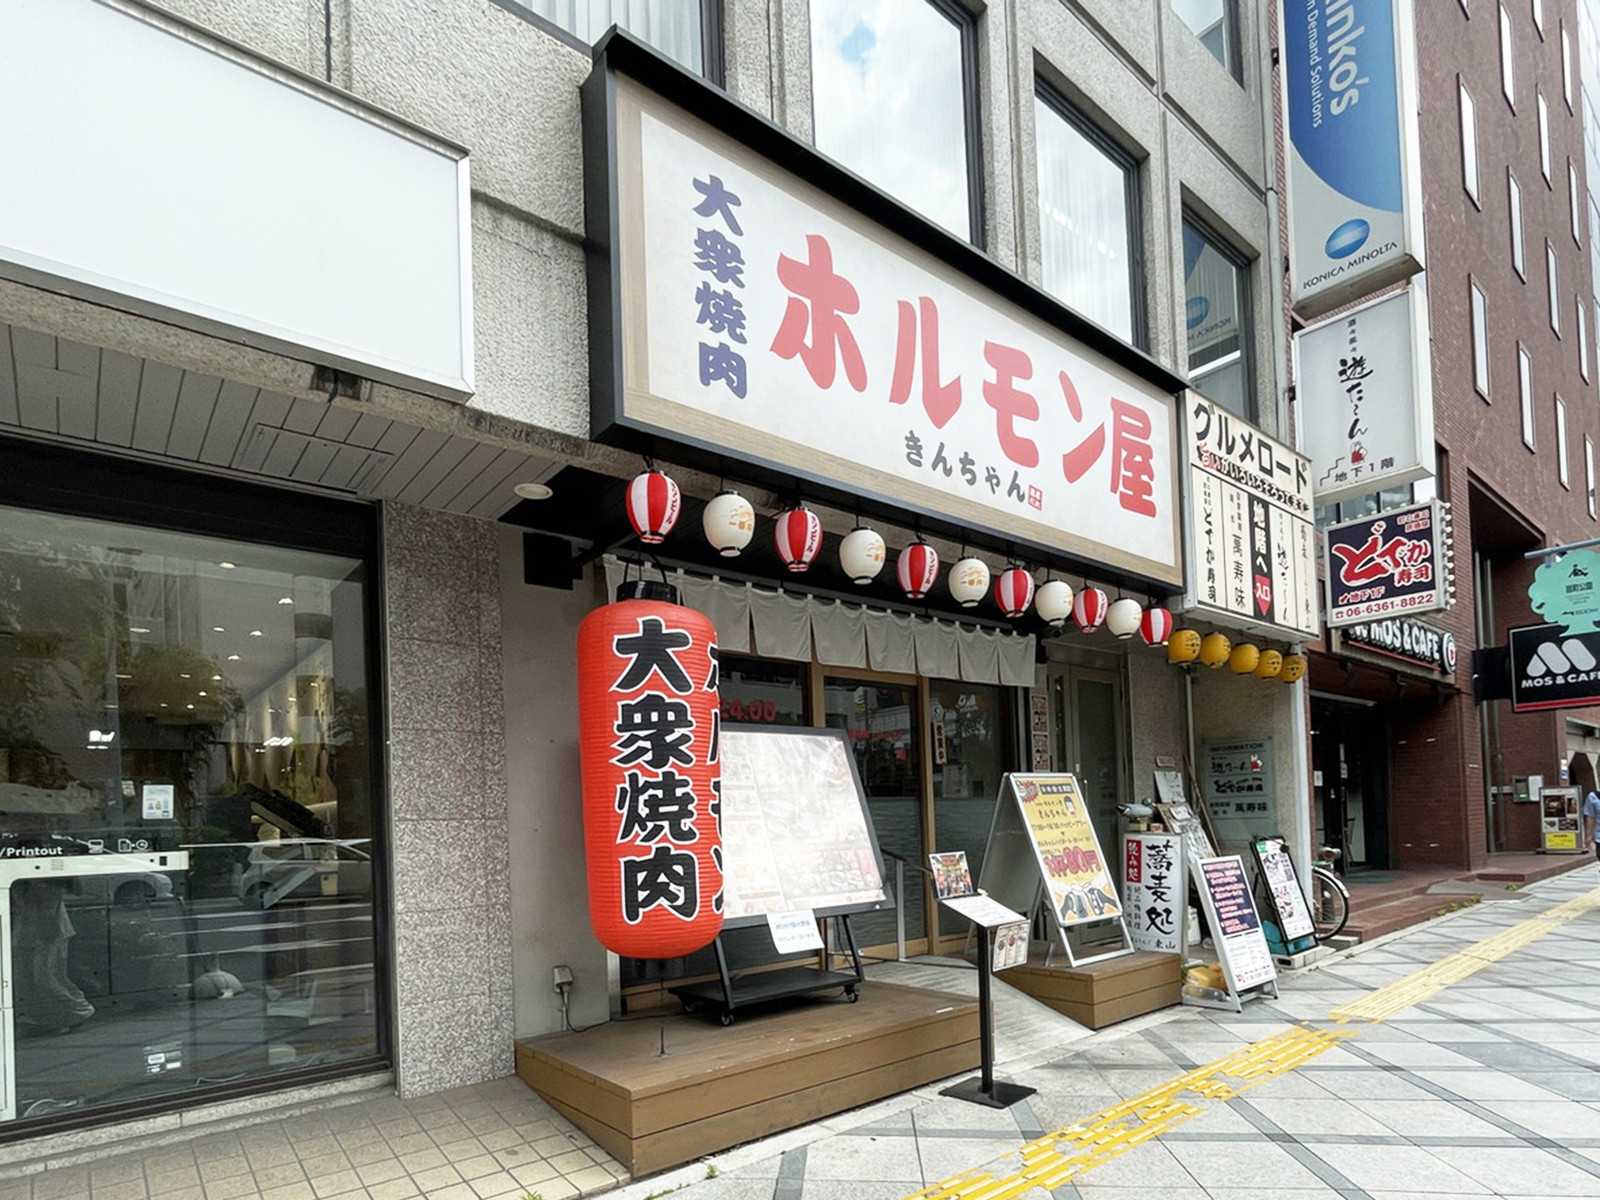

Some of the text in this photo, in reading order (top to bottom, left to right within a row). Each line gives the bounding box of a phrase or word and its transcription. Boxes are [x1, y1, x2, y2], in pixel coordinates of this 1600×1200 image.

[1307, 9, 1322, 66] Demand
[1310, 65, 1324, 128] Solutions
[692, 174, 748, 399] 大衆焼肉
[1303, 241, 1398, 290] KONICA MINOLTA
[769, 233, 1157, 518] ホルモン屋
[904, 430, 1026, 503] きんちゃん
[1193, 402, 1308, 495] グルメロード
[1334, 457, 1395, 483] 地下1階
[1255, 581, 1271, 601] 入口
[1394, 564, 1432, 588] 寿司
[1371, 619, 1440, 661] MOS & CAFE
[1521, 676, 1553, 688] MOS
[1555, 675, 1566, 685] &
[609, 616, 697, 924] 大衆焼肉
[1145, 839, 1175, 936] 蕎麦処
